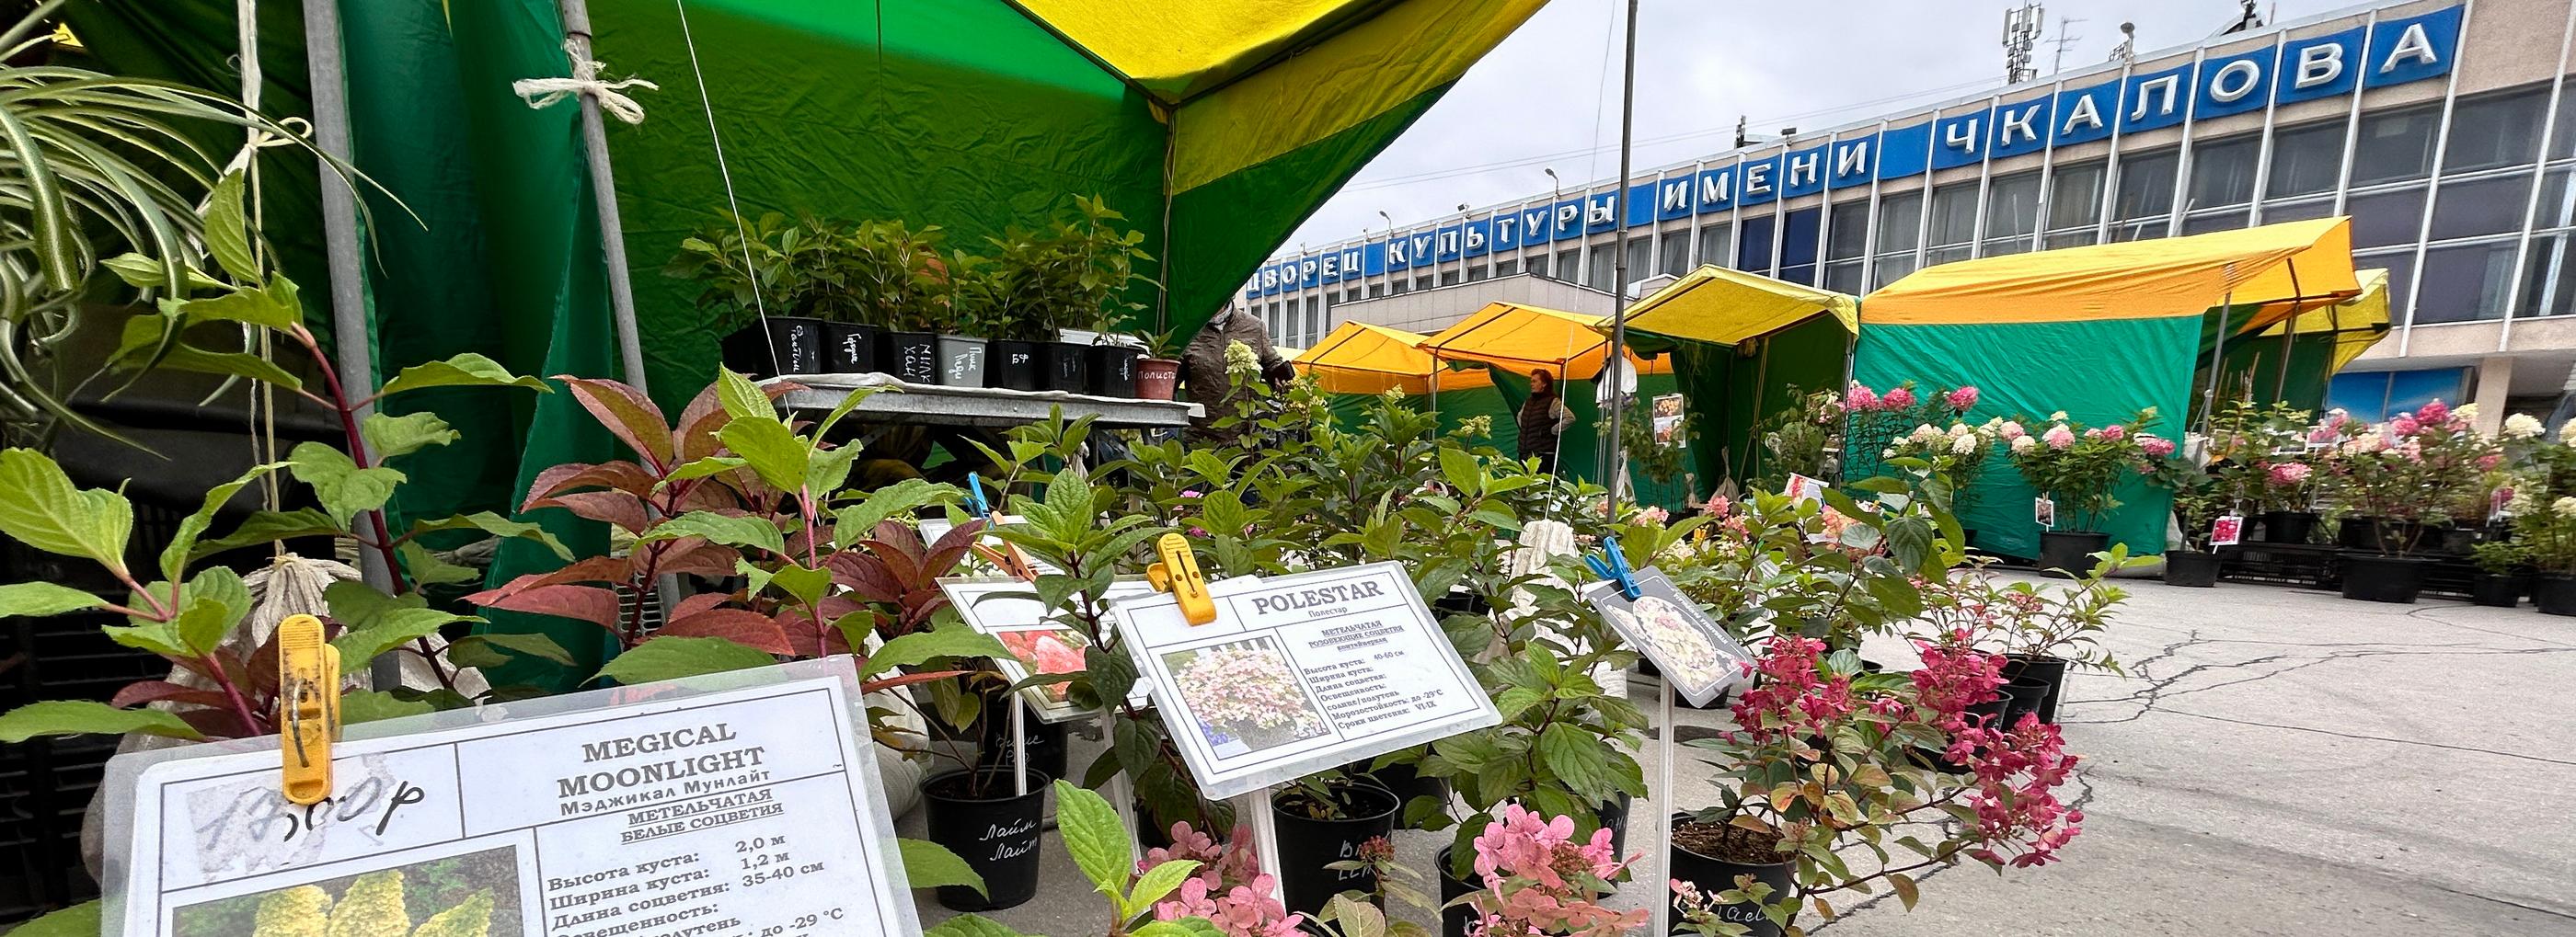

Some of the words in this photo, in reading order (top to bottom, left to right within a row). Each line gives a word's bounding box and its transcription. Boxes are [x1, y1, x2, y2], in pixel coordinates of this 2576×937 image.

[1247, 251, 1360, 291] ДВОРЕЦ
[1389, 196, 1616, 264] КУЛЬТУРЫ
[1664, 142, 1867, 211] ИМЕНИ
[1946, 23, 2438, 154] ЧКАЛОВА
[1251, 581, 1385, 615] POLESTAR
[1308, 607, 1348, 618] Полестар
[1308, 633, 1363, 648] РОЗОВЕЮЩИЕ
[1365, 625, 1405, 637] СОЦВЕТИЯ
[1321, 620, 1383, 636] МЕТЕЛЬЧАТАЯ
[1304, 664, 1337, 675] Высота
[1339, 658, 1365, 669] куста:
[1374, 652, 1394, 660] 40-60
[1308, 673, 1346, 683] Ширина
[1347, 667, 1374, 677] куста:
[1316, 683, 1344, 693] Длина
[1345, 674, 1386, 686] соцветия:
[1331, 698, 1409, 720] Морозостойкость:
[1338, 718, 1366, 730] Сроки
[1367, 708, 1410, 723] цветения:
[1415, 701, 1437, 711] VI-IX
[581, 723, 736, 763] MEGICAL
[557, 746, 765, 798] MOONLIGHT
[560, 784, 676, 817] Мэджикал
[684, 770, 770, 794] Мунлайт
[627, 788, 773, 826] МЕТЕЛЬЧАТАЯ
[620, 821, 685, 843] БЕЛЫЕ
[690, 802, 784, 829] СОЦВЕТИЯ
[979, 817, 1037, 840] Лайм
[547, 864, 629, 892] Высота
[636, 852, 700, 874] куста:
[736, 837, 765, 852] 2,0
[771, 835, 786, 845] м
[989, 837, 1037, 861] Лайт
[550, 884, 640, 911] Ширина
[646, 869, 709, 891] куста:
[741, 855, 772, 871] 1,2
[775, 852, 789, 863] м
[552, 906, 622, 931] Длина
[628, 881, 730, 914] соцветия:
[742, 865, 795, 888] 35-40
[800, 861, 824, 874] см
[789, 914, 818, 929] -29
